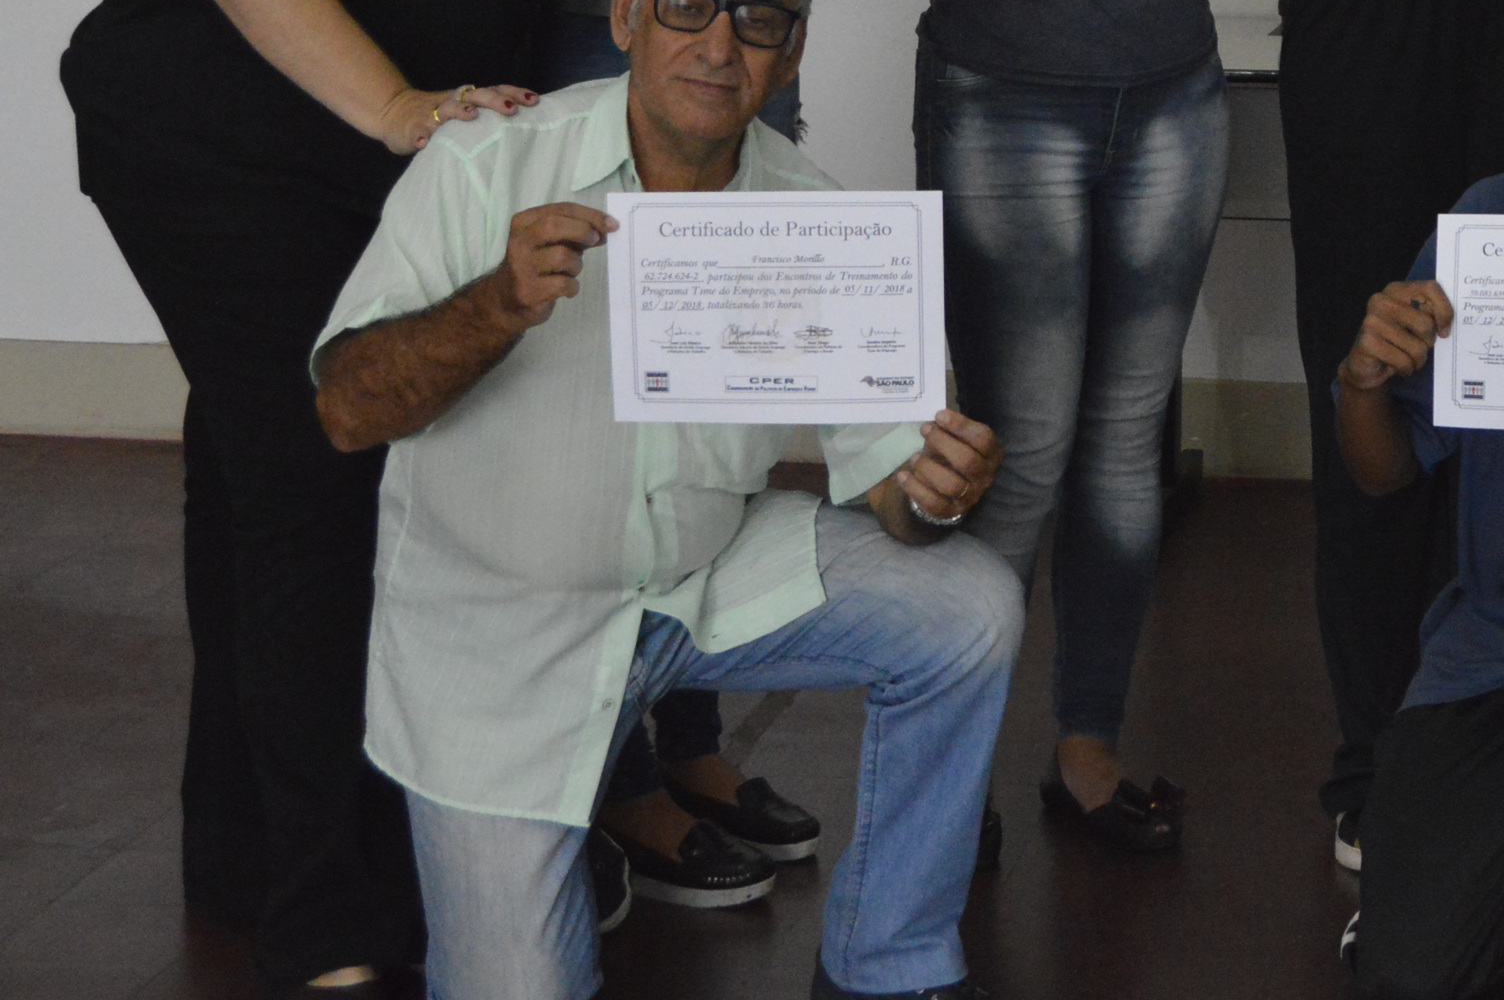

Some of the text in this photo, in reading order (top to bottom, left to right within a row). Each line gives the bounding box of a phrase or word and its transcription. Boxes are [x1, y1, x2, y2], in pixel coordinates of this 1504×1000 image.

[659, 220, 892, 241] Certificado de Participação
[640, 257, 698, 270] Certificamos
[702, 260, 718, 269] que
[751, 254, 792, 263] Francisco
[890, 256, 912, 266] R.G.
[706, 272, 754, 284] participou
[757, 271, 772, 281] dos
[775, 271, 822, 281] Encontros
[824, 271, 835, 280] de
[839, 270, 897, 280] Treinamento
[900, 270, 913, 280] do
[748, 376, 795, 384] CPER
